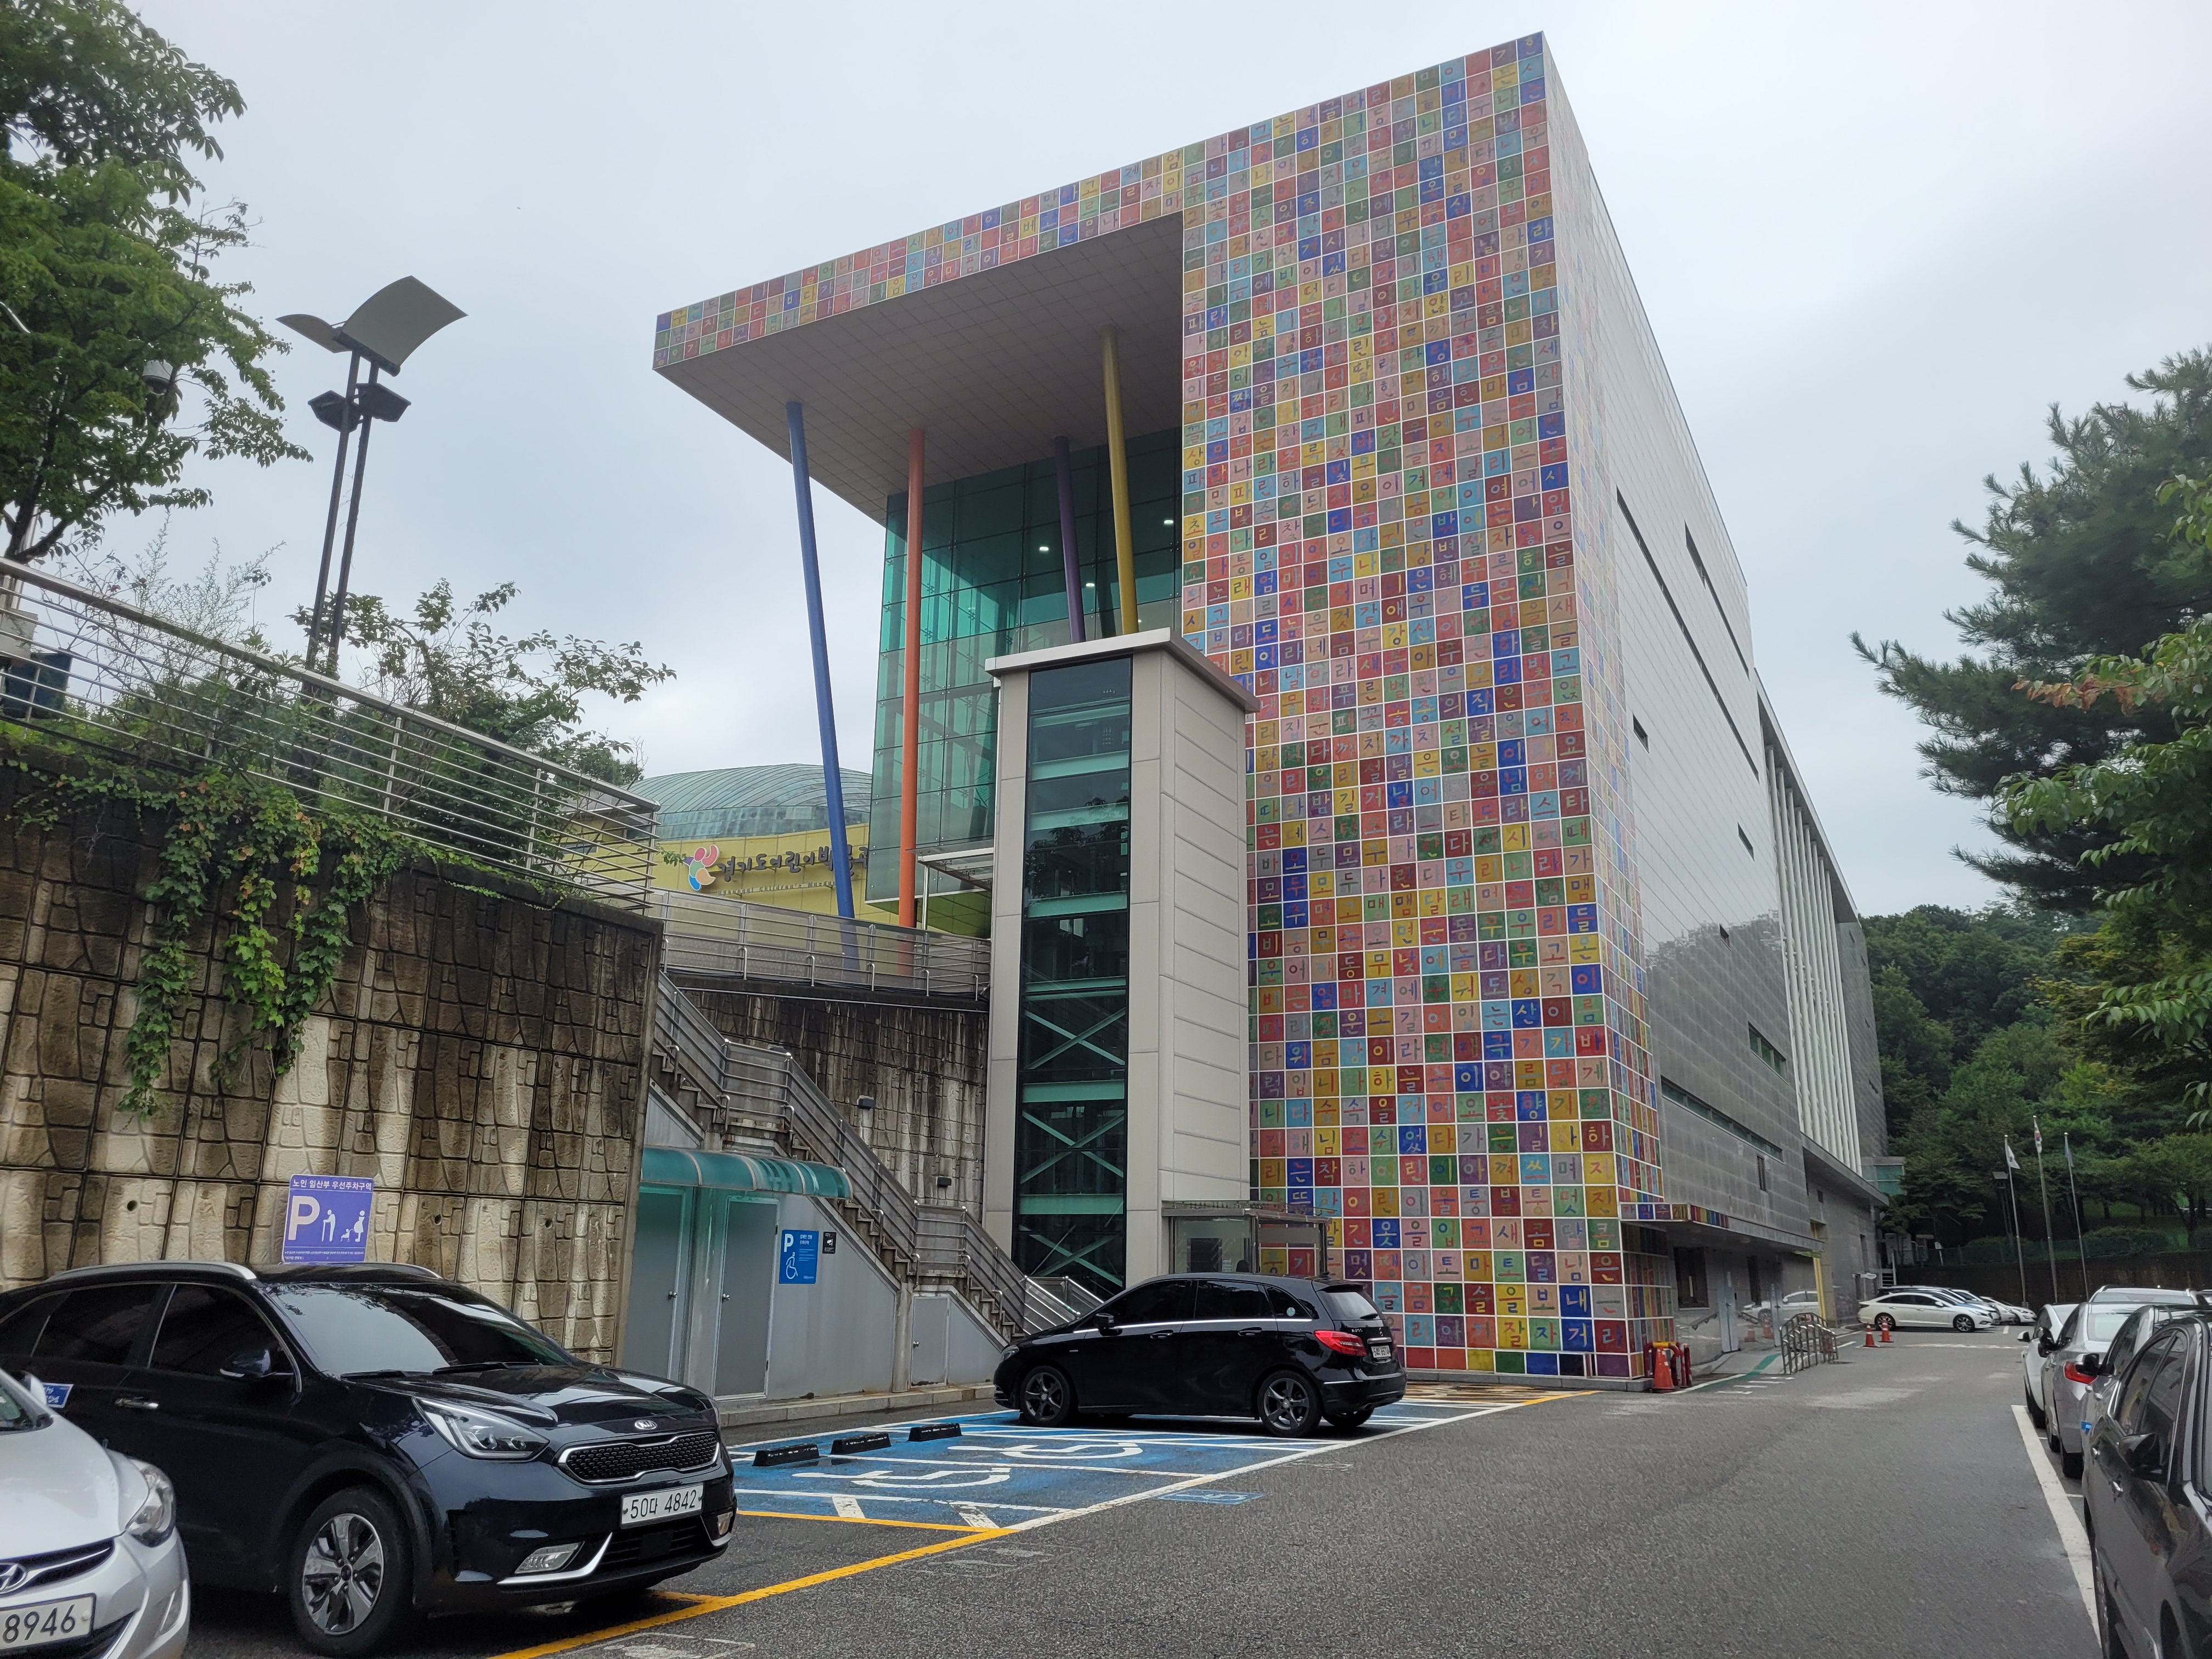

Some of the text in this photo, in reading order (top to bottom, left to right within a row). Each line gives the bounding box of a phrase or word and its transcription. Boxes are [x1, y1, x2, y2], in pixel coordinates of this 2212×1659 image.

[292, 1180, 372, 1191] 노인 임산부 우선주차구역
[288, 1195, 320, 1240] P
[783, 1233, 794, 1252] P
[664, 1489, 697, 1513] 4842
[2, 1604, 76, 1644] 8946
